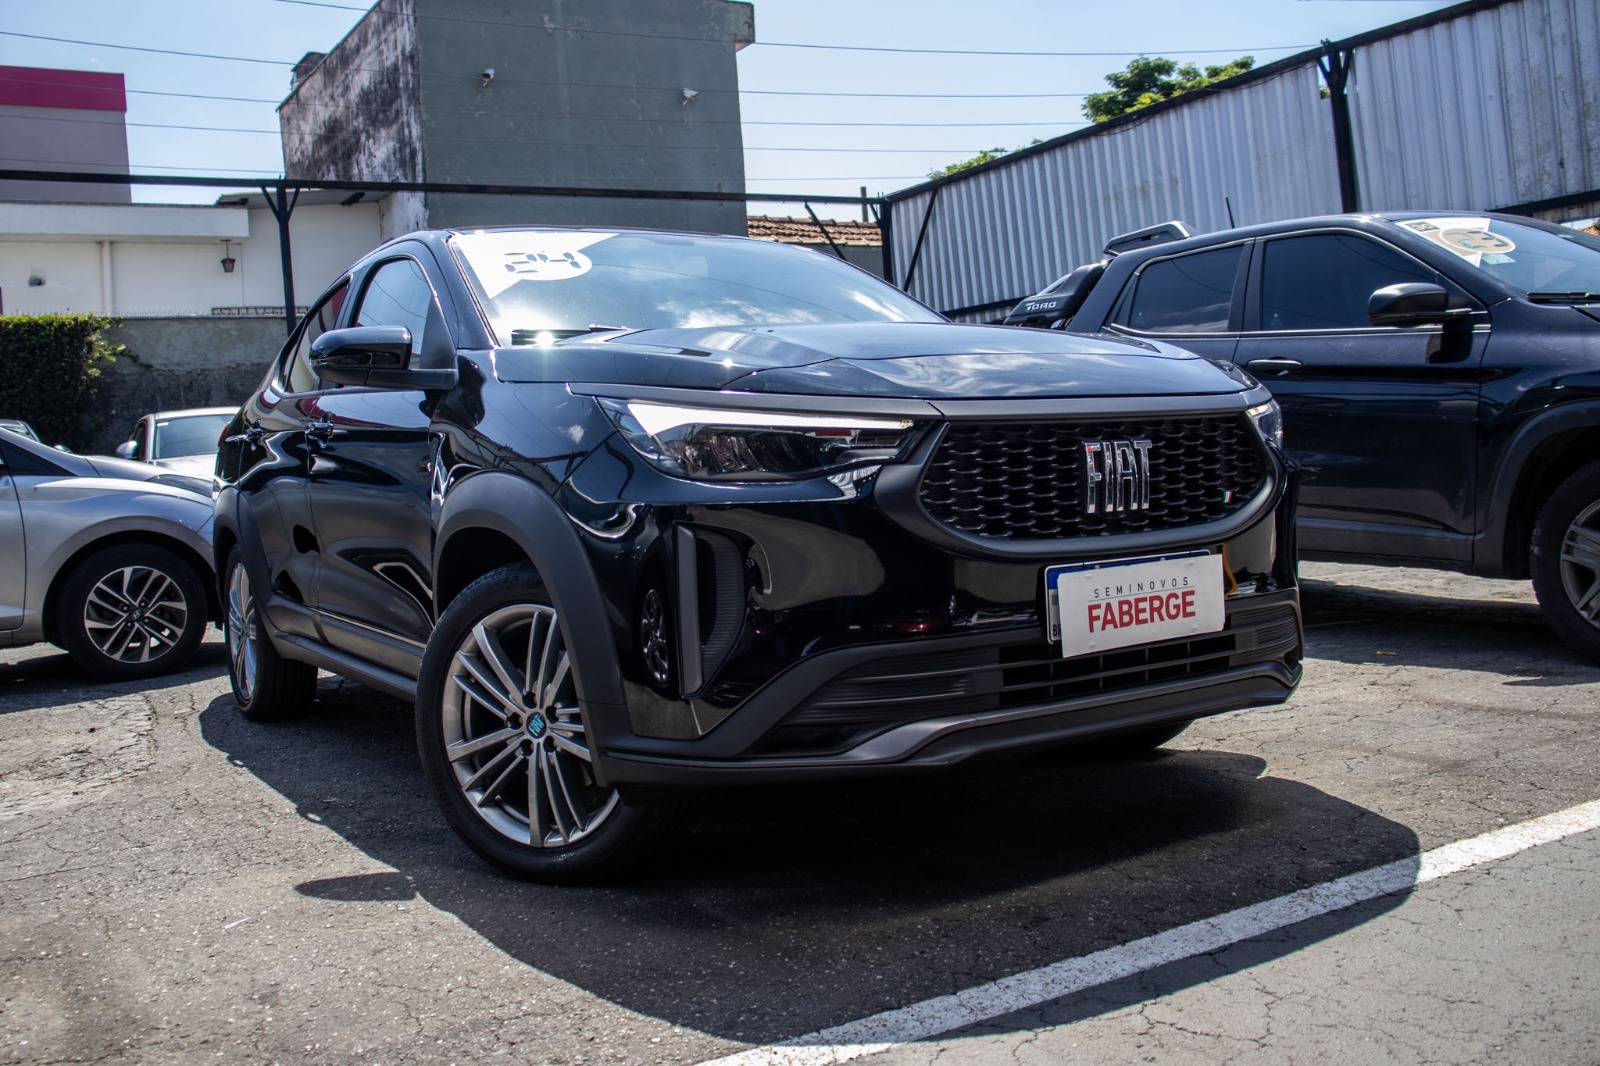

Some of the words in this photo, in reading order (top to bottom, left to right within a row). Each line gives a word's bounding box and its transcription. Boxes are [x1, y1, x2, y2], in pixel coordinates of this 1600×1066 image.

[1025, 301, 1057, 311] TORO
[1083, 439, 1153, 514] FIAT
[1093, 576, 1190, 599] SEMINOVOS
[1087, 590, 1196, 633] FABERGE
